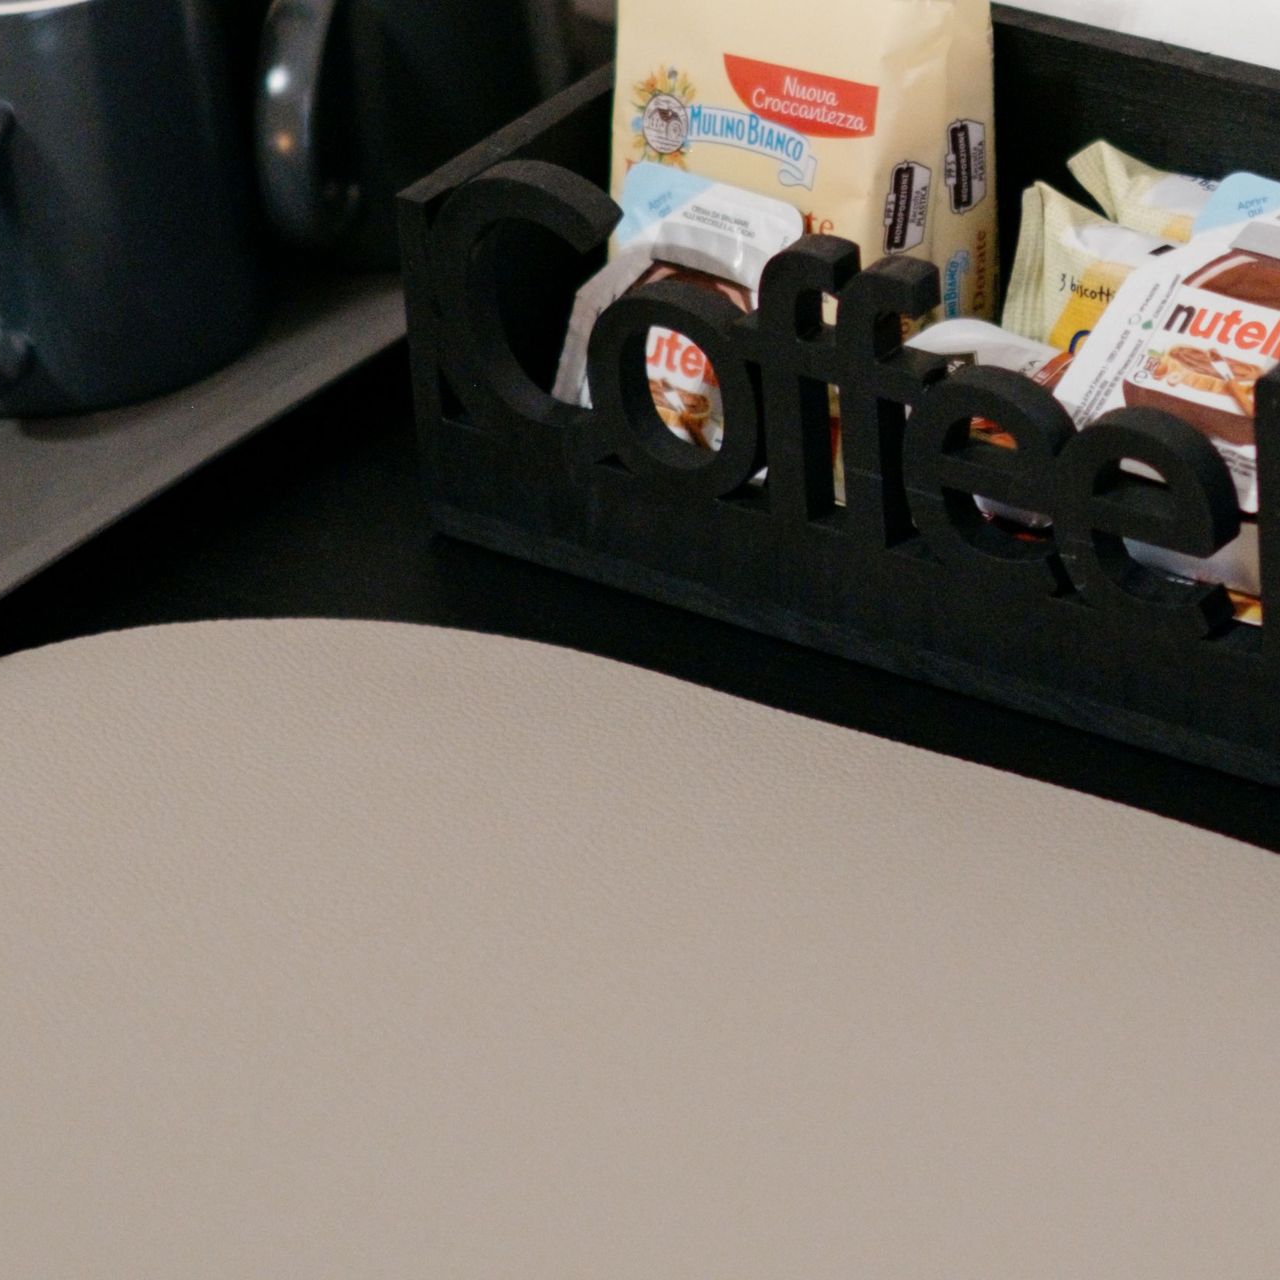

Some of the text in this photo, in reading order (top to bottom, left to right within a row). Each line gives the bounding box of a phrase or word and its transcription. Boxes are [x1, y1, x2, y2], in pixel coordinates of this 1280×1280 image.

[751, 88, 867, 132] Croccantezza
[783, 75, 839, 107] Nuova
[688, 104, 803, 161] MULINO BIANCO
[958, 131, 969, 203] MONOPORZIONE
[977, 140, 985, 182] PLASTICA
[894, 173, 910, 243] MONOPORZIONE
[916, 184, 928, 227] PLASTICA
[973, 230, 986, 312] Dorate
[1059, 273, 1066, 292] 3
[1071, 280, 1116, 303] biscotti
